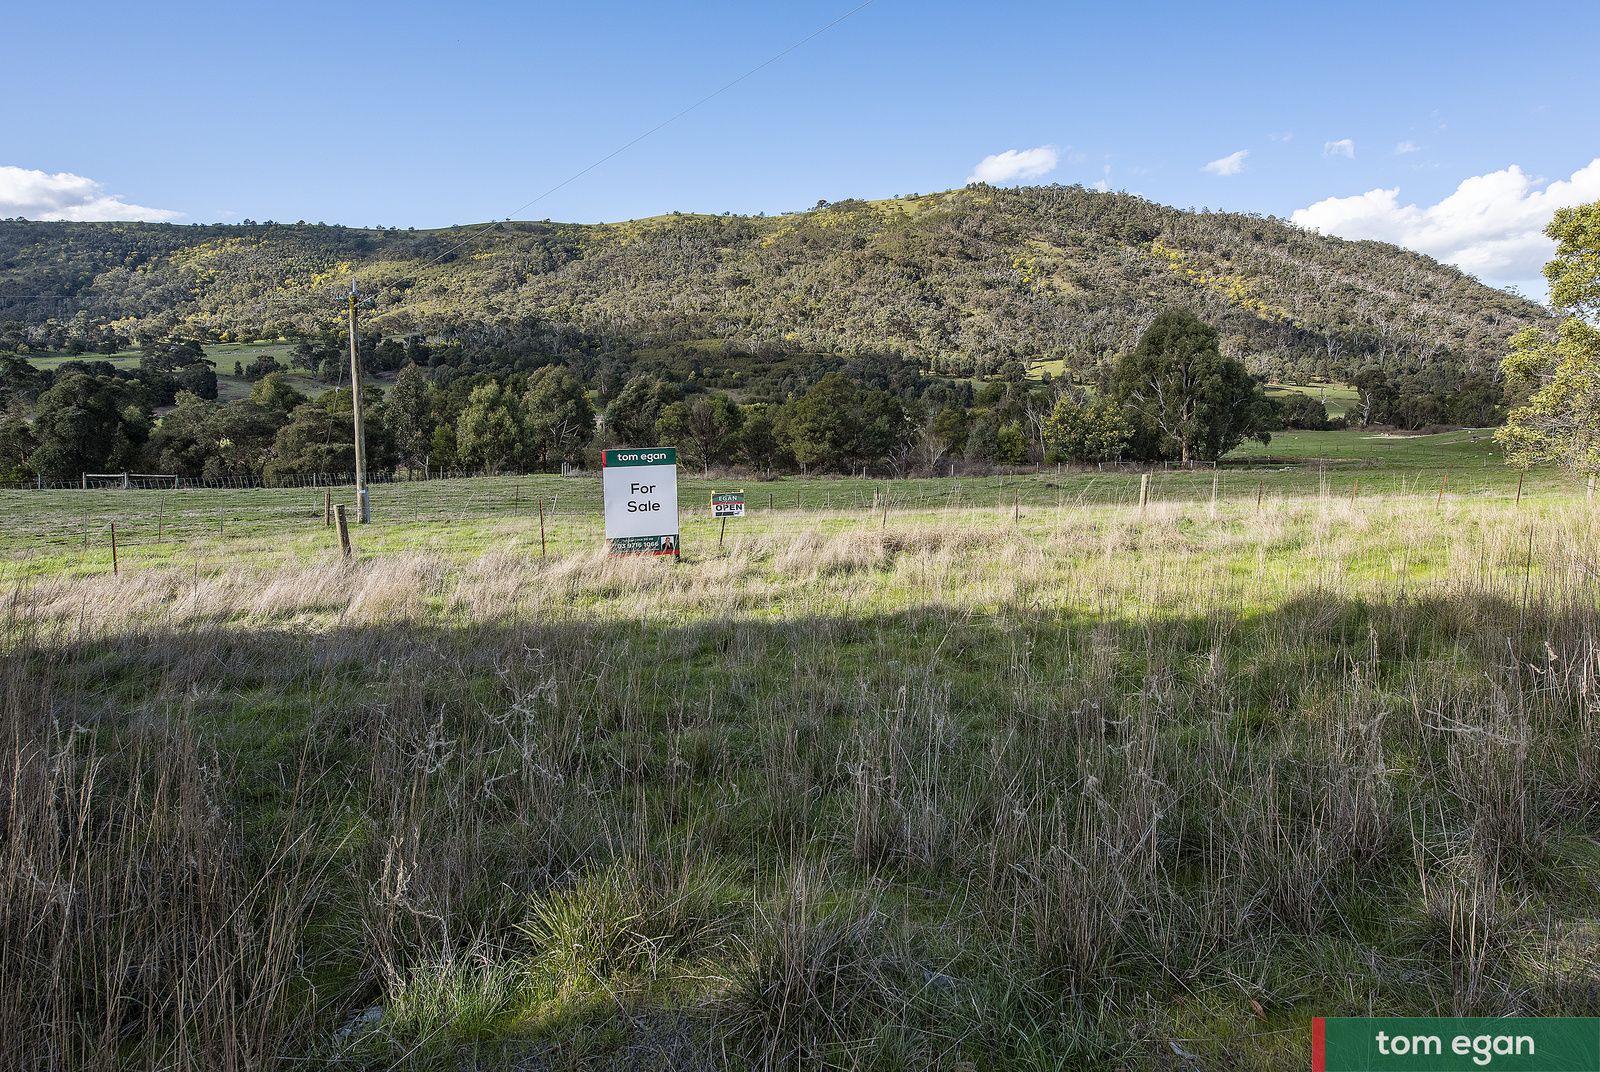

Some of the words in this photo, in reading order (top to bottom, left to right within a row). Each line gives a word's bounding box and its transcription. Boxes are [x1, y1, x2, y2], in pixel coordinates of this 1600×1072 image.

[617, 453, 638, 461] tom
[640, 453, 667, 463] egan
[631, 483, 656, 494] For
[627, 500, 661, 512] Sale
